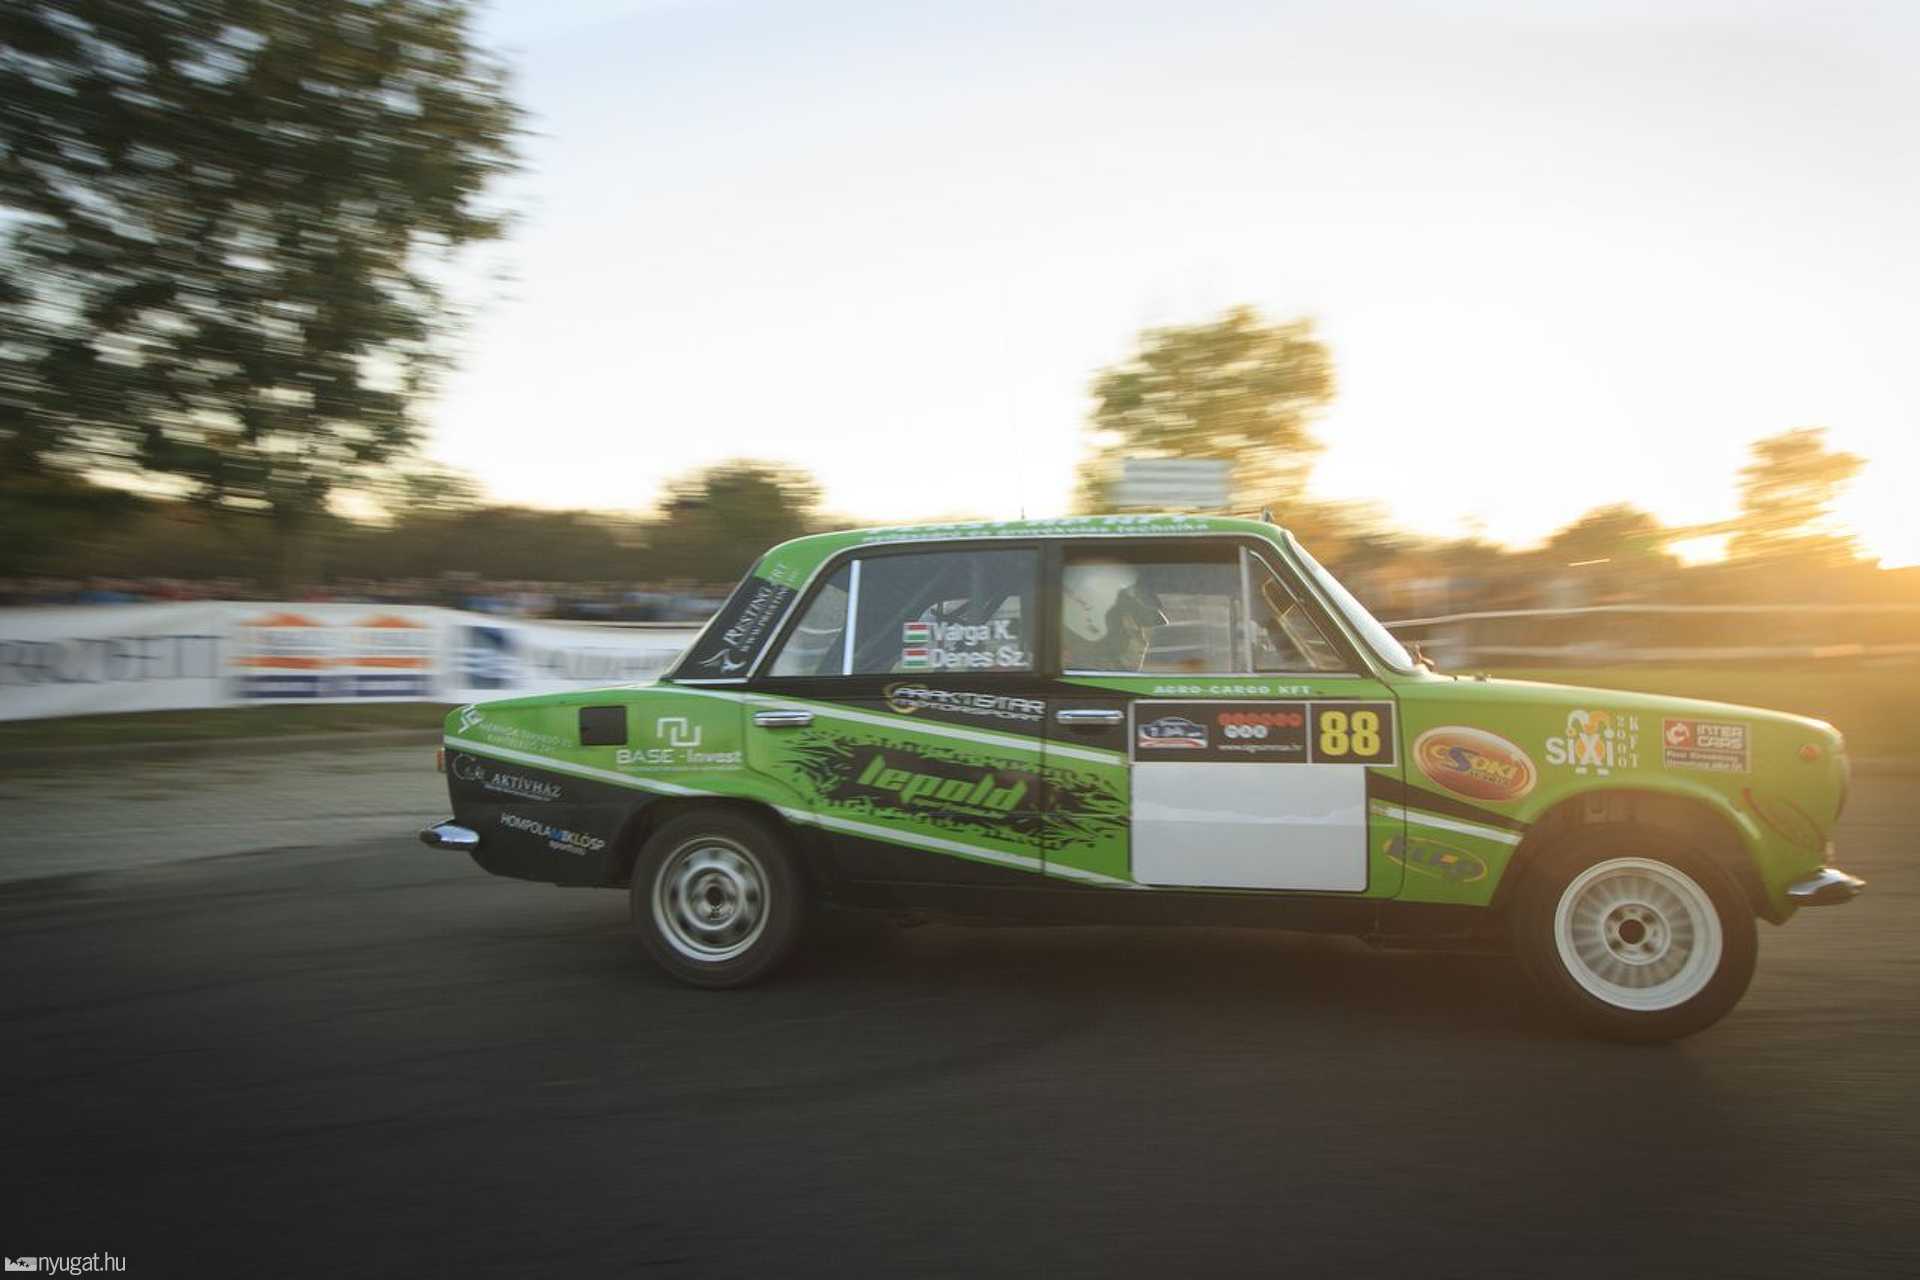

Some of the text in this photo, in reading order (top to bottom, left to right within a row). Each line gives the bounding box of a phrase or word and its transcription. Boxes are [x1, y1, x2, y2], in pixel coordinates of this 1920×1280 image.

[931, 621, 991, 646] Varga
[1319, 711, 1381, 756] 88
[615, 748, 673, 764] BASE
